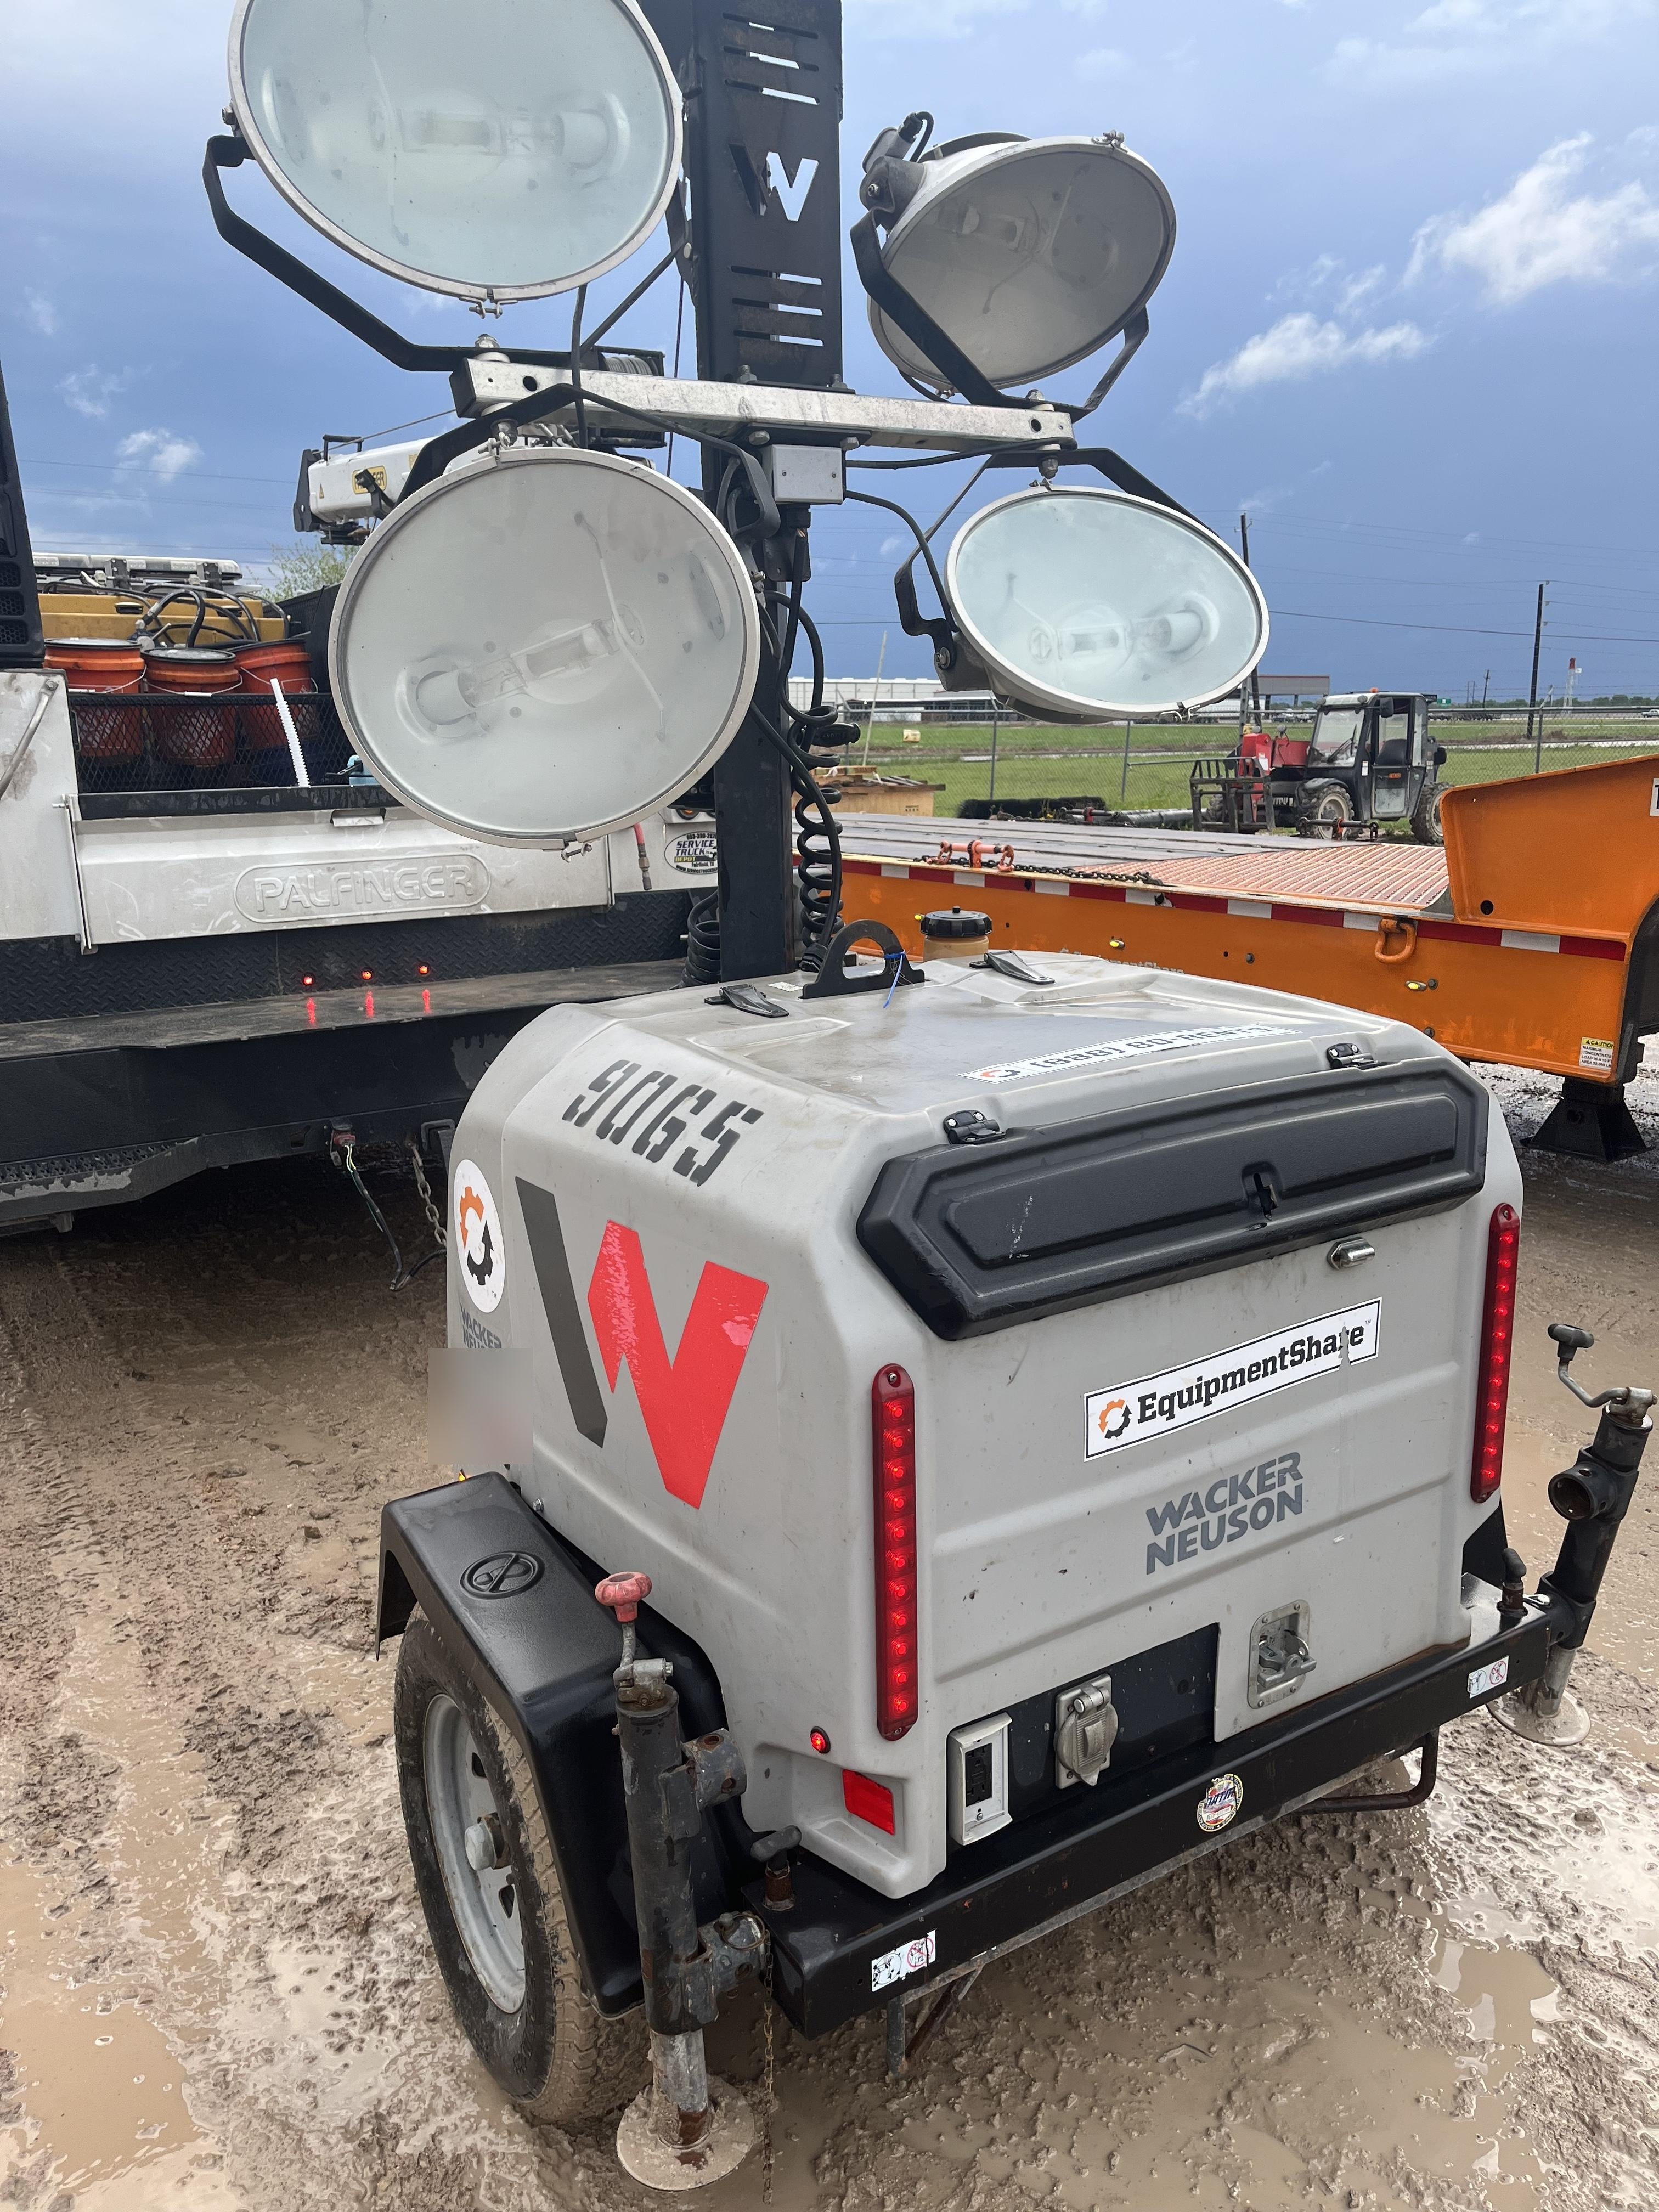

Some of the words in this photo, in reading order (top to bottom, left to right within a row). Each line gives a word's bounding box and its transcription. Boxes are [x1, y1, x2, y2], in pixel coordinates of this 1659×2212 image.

[676, 840, 714, 848] SERVICE
[676, 848, 705, 856] TRUCK
[254, 864, 475, 912] PALFINGER
[1030, 1047, 1125, 1068] (888)
[1125, 1027, 1272, 1049] 80-RENTS
[1591, 1040, 1615, 1048] CAUTION
[1146, 1452, 1303, 1536] WACKER
[1146, 1483, 1302, 1575] NEUSON
